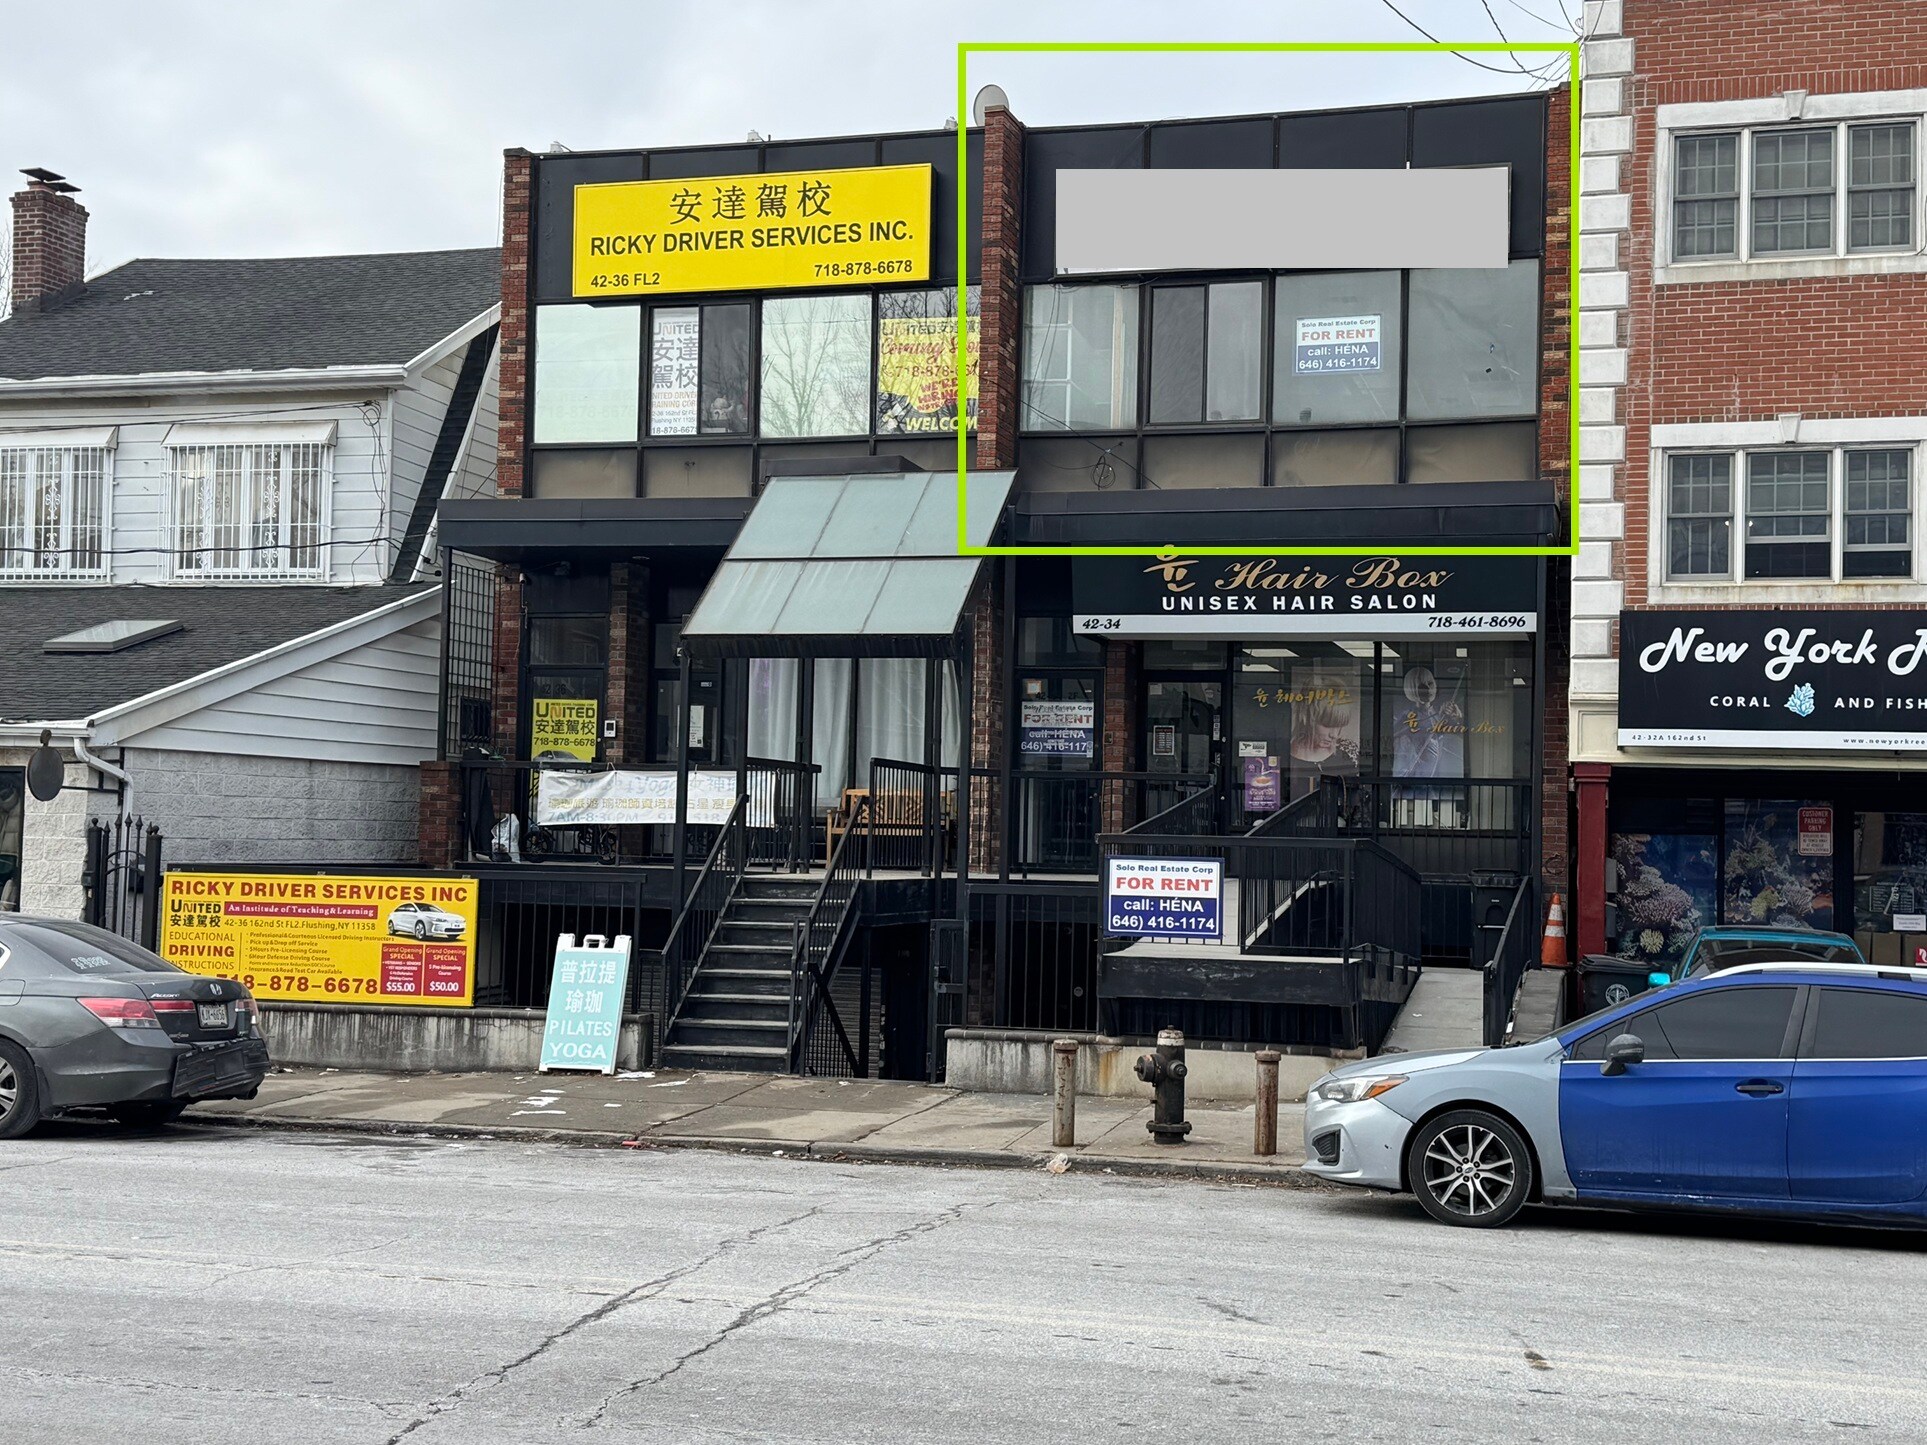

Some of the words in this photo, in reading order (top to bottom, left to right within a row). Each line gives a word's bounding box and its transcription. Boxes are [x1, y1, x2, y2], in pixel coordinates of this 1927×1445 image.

[669, 180, 832, 225] 安達駕校
[591, 234, 657, 256] RICKY
[663, 229, 744, 252] DRIVER
[751, 223, 862, 248] SERVICES
[869, 220, 913, 241] INC.
[814, 260, 913, 277] 718-878-6678
[591, 275, 629, 287] 42-36
[634, 273, 660, 285] FL2
[1302, 331, 1331, 341] FOR
[1336, 328, 1375, 339] RENT
[1308, 347, 1331, 356] call:
[1326, 357, 1377, 367] 416-1174
[1215, 559, 1339, 592] Hair
[1346, 557, 1455, 588] Box
[1162, 596, 1257, 611] UNISEX
[1273, 596, 1334, 610] HAIR
[1350, 594, 1436, 609] SALON
[1082, 618, 1121, 629] 42-34
[1428, 616, 1526, 628] 718-461-8696
[1639, 627, 1749, 673] New
[1764, 628, 1878, 681] York
[1710, 696, 1771, 707] CORAL
[1834, 697, 1875, 709] AND
[1886, 698, 1927, 709] FISH
[536, 703, 596, 718] UNITED
[1024, 714, 1050, 723] FOR
[1055, 714, 1092, 724] RENT
[535, 719, 596, 735] 安達駕校
[534, 737, 596, 747] 718-878-6678
[1046, 742, 1087, 751] 416-117
[171, 881, 235, 896] RICKY
[241, 882, 316, 898] DRIVER
[322, 884, 425, 900] SERVICES
[432, 887, 468, 901] INC
[1116, 877, 1154, 889] FOR
[1161, 878, 1213, 891] RENT
[171, 899, 221, 914] UNITED
[281, 906, 291, 914] of
[1124, 899, 1154, 910] call:
[170, 914, 221, 928] 安達駕校
[224, 919, 248, 927] 42-36
[250, 919, 274, 928] 162nd
[276, 920, 284, 928] St
[352, 922, 376, 930] 11358
[1148, 916, 1215, 930] 416-1174
[169, 932, 235, 941] EDUCATIONAL
[169, 945, 235, 957] DRIVING
[443, 948, 466, 956] Opening
[561, 960, 617, 984] 普拉提
[386, 981, 415, 992] $55.00
[429, 981, 459, 992] $50.00
[565, 988, 604, 1014] 瑜珈
[549, 1020, 613, 1037] PILATES
[550, 1042, 607, 1059] YOGA
